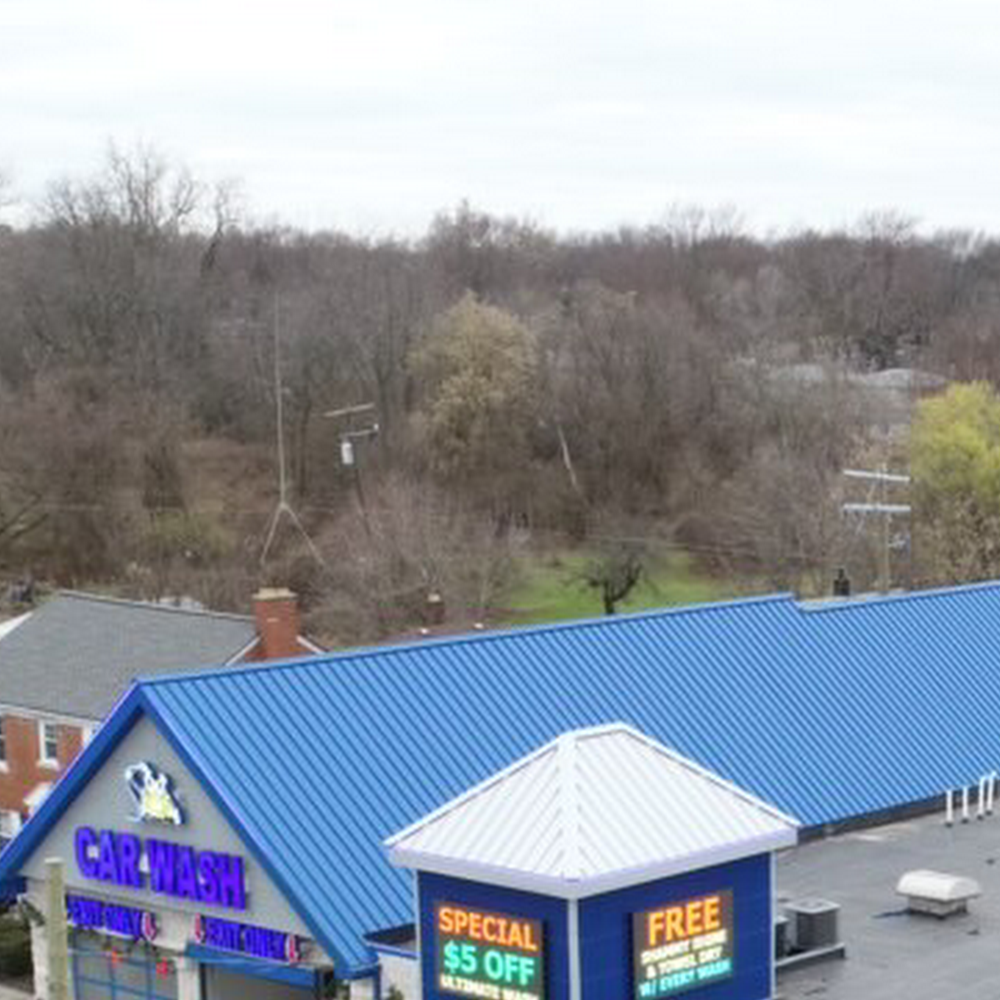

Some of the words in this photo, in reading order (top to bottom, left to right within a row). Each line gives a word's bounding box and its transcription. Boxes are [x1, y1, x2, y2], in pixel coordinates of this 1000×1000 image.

[75, 827, 142, 888] CAR
[146, 840, 245, 911] WASH
[440, 909, 538, 951] SPECIAL
[649, 897, 720, 947] FREE
[444, 940, 477, 975] $5
[484, 949, 535, 986] OFF
